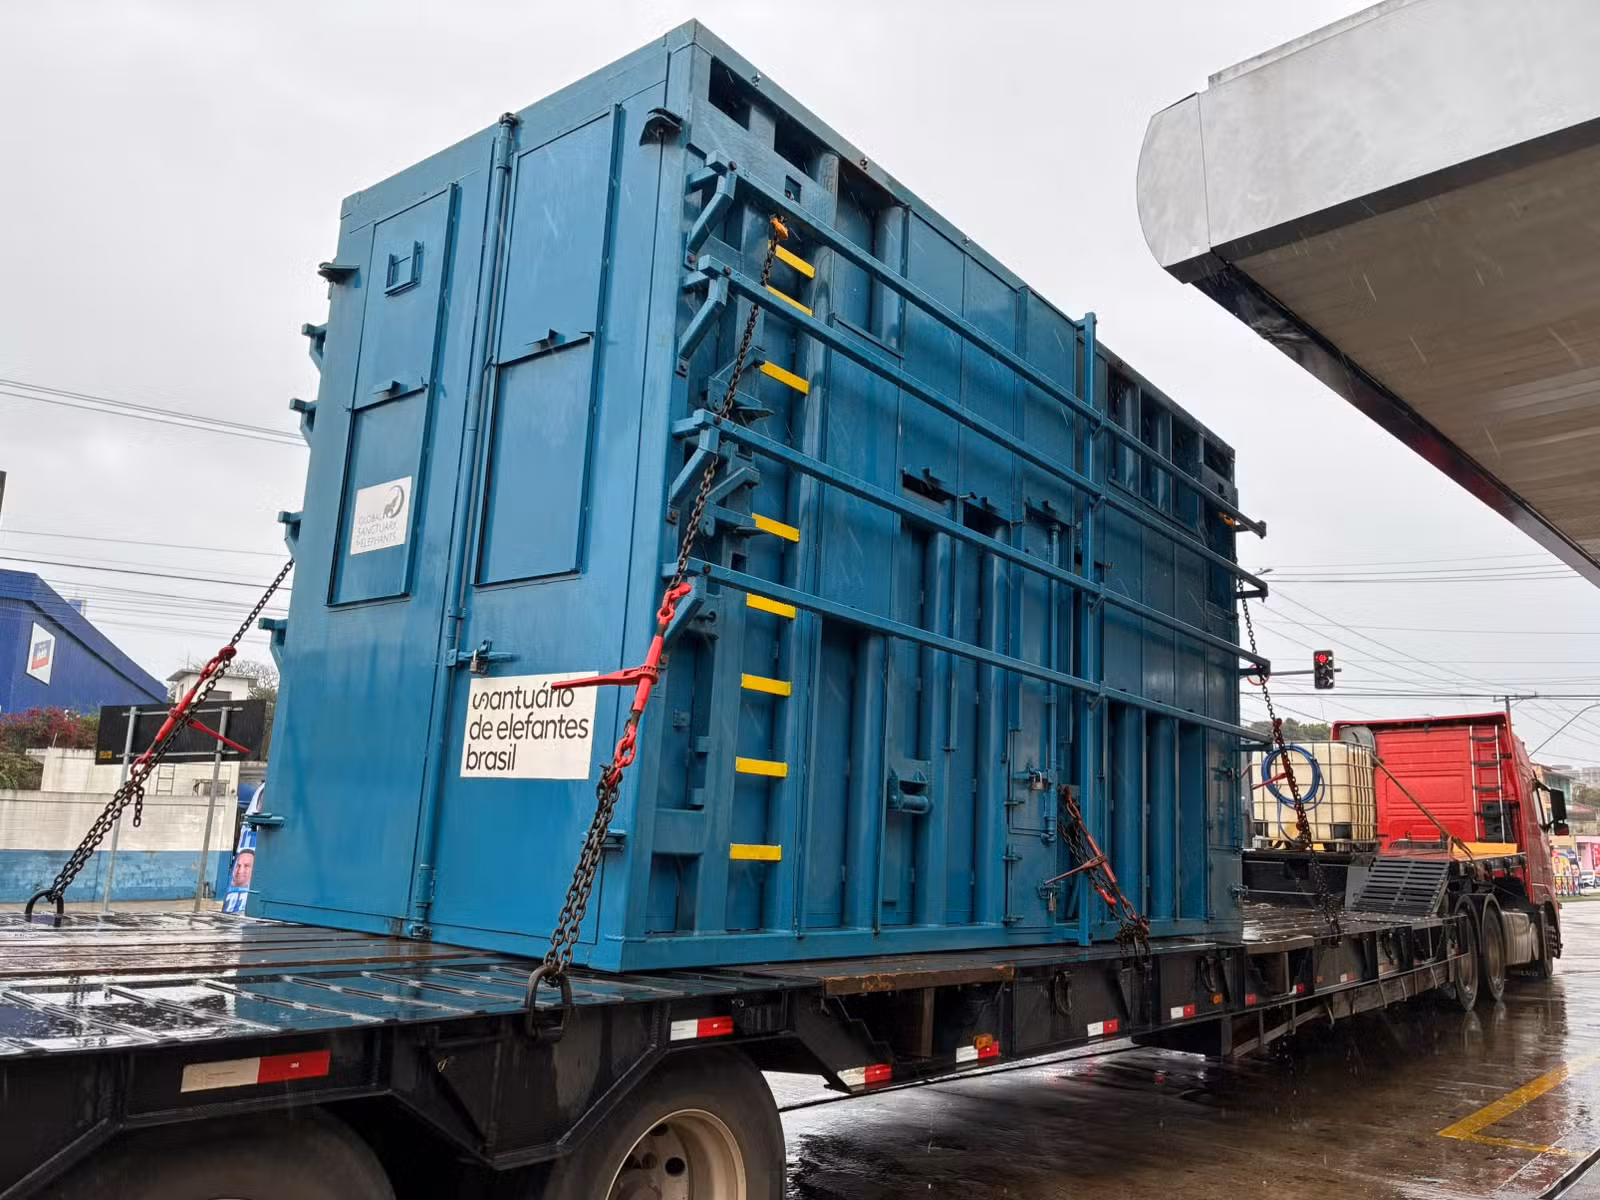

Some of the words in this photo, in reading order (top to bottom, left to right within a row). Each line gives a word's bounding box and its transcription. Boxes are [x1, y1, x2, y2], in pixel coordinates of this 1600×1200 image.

[472, 681, 575, 710] santuário
[469, 714, 493, 740] de
[496, 711, 589, 740] elefantes
[466, 743, 517, 771] brasil
